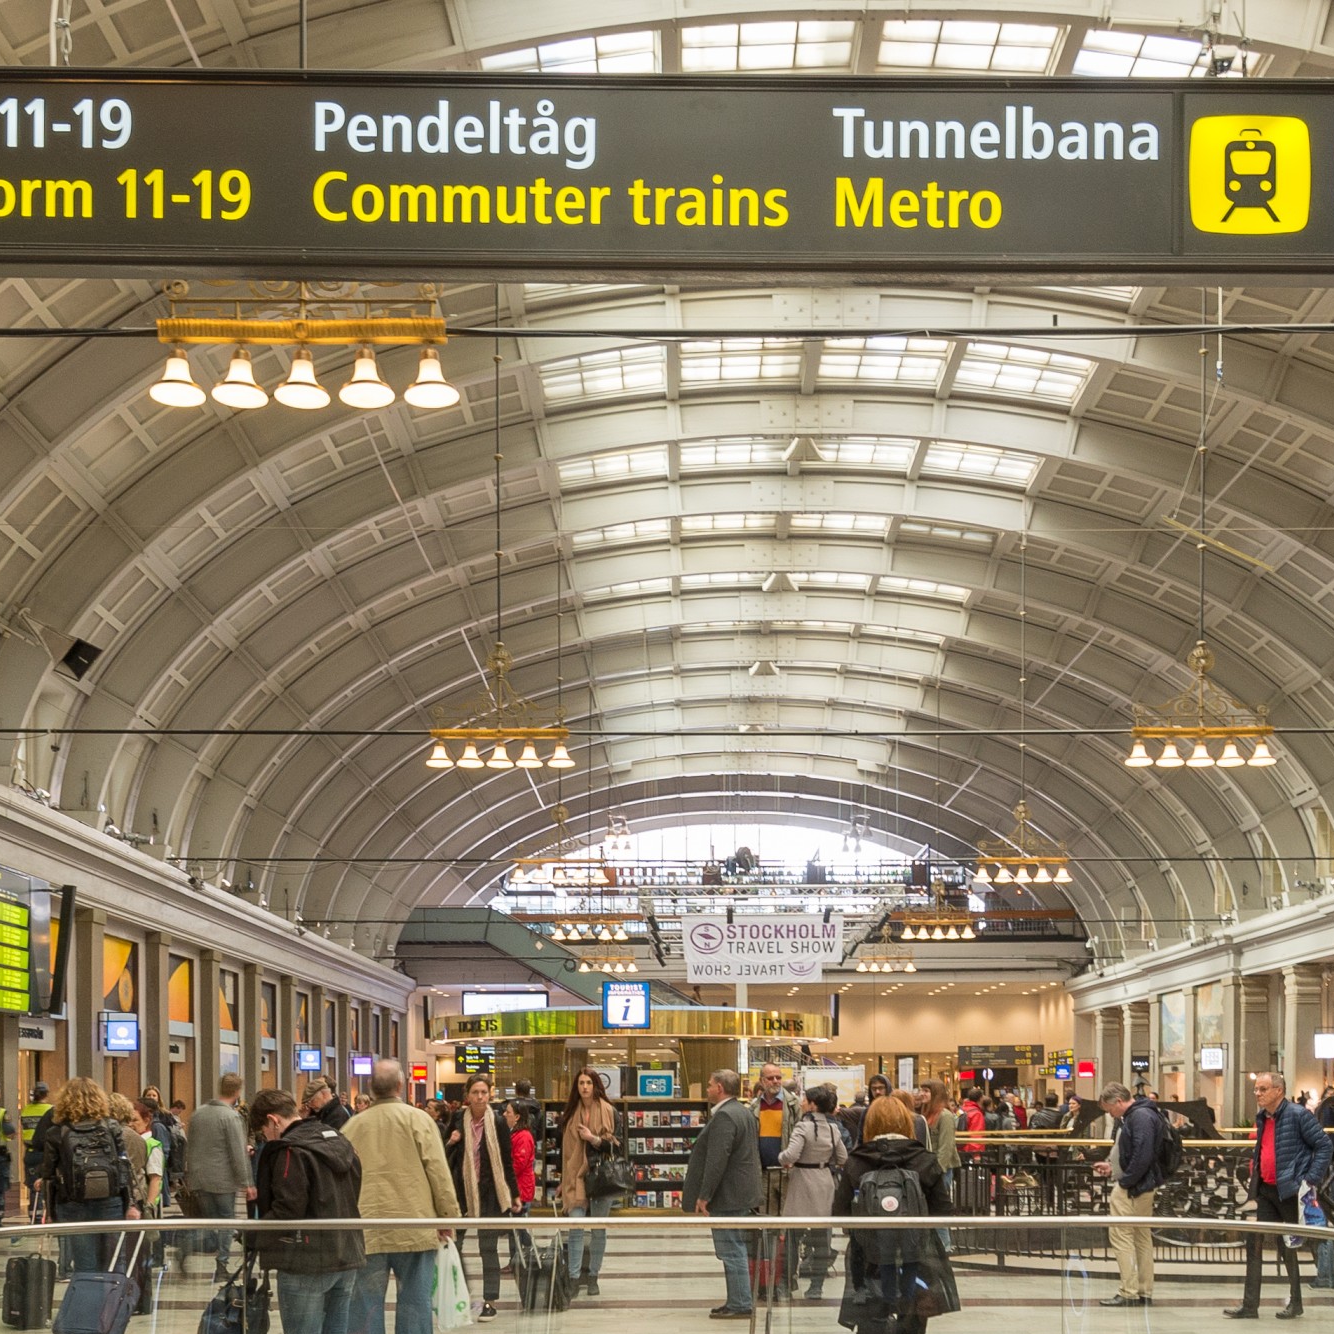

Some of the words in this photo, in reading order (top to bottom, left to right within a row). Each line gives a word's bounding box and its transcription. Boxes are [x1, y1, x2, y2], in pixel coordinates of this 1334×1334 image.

[314, 99, 597, 170] Pendeltåg
[833, 105, 1159, 163] Tunnelbana
[118, 169, 252, 220] 11-19
[313, 171, 611, 225] Commuter
[628, 174, 790, 227] trains
[834, 177, 1003, 229] Metro
[727, 924, 836, 940] STOCKHOLM
[727, 941, 784, 954] TRAVEL
[790, 941, 835, 954] SHOW
[457, 1019, 498, 1032] TICKETS
[761, 1018, 803, 1032] TICKETS
